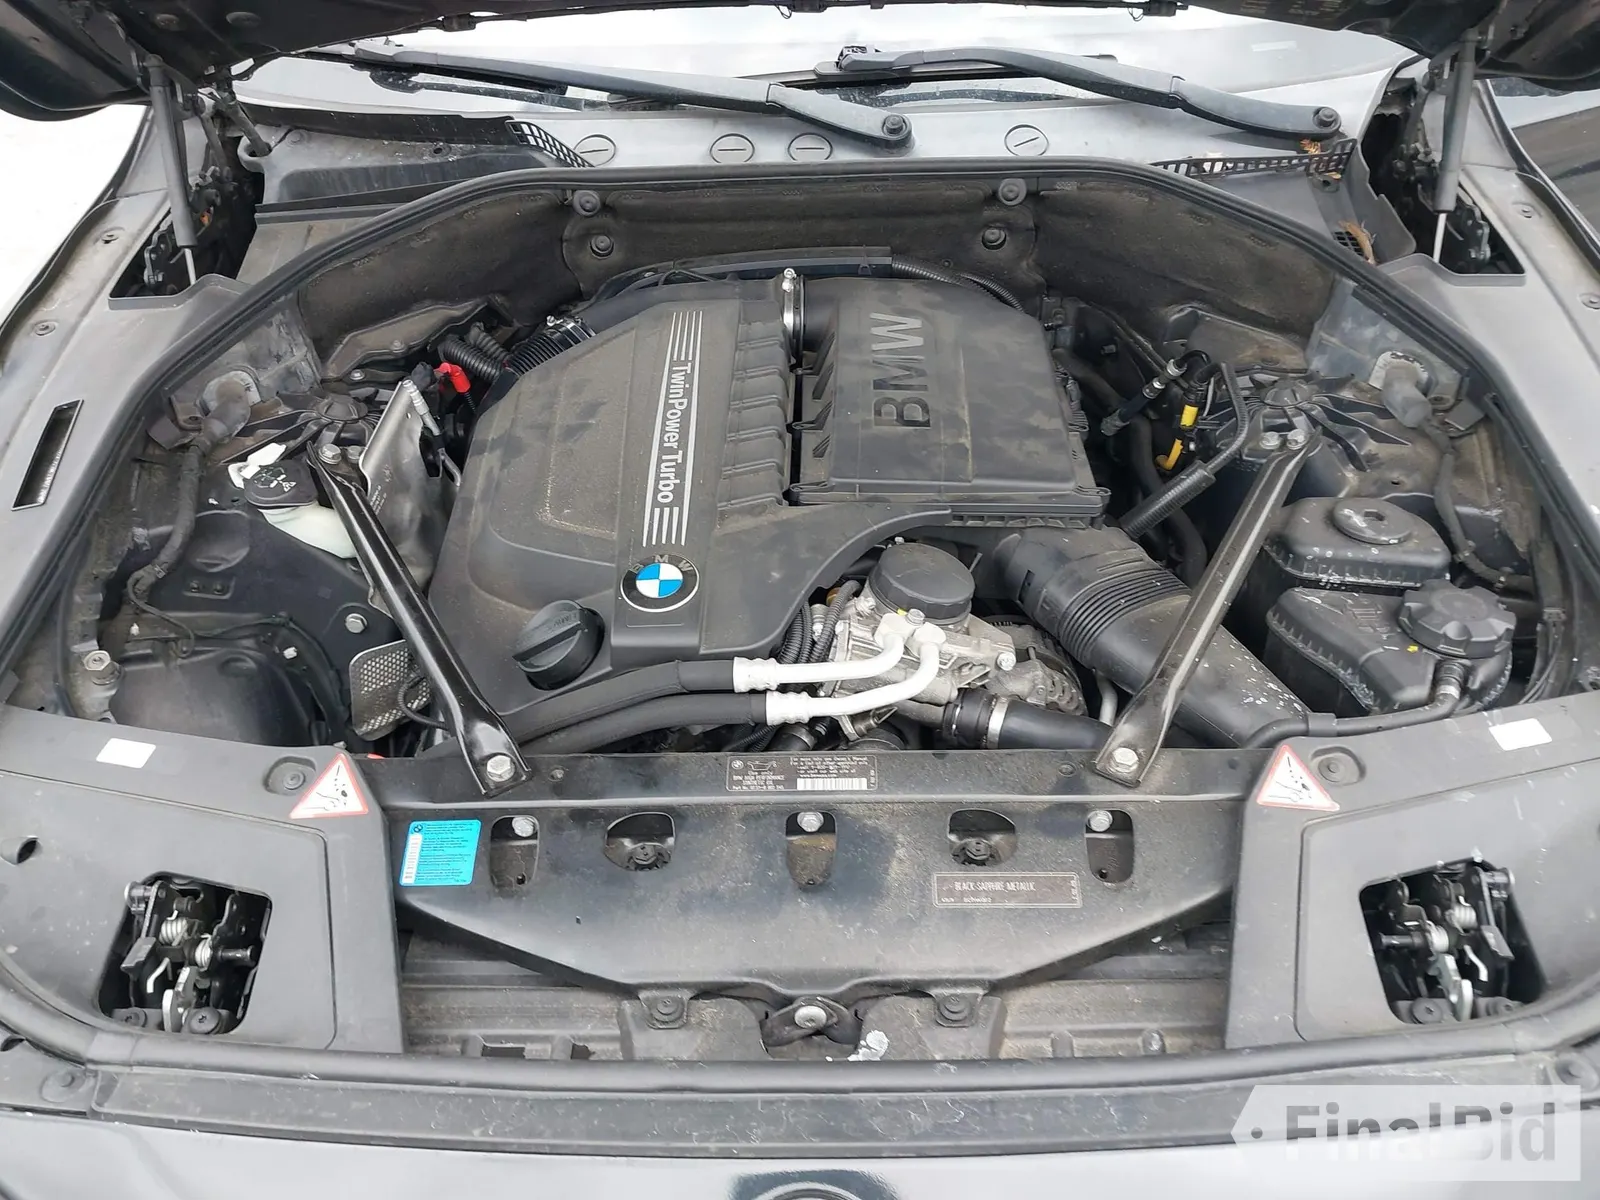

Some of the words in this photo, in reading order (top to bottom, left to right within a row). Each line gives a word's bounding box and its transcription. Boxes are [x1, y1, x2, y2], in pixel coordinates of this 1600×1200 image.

[869, 312, 932, 428] BMW
[663, 362, 692, 449] TwinPower
[657, 450, 683, 503] Turbo
[629, 554, 694, 574] BMW
